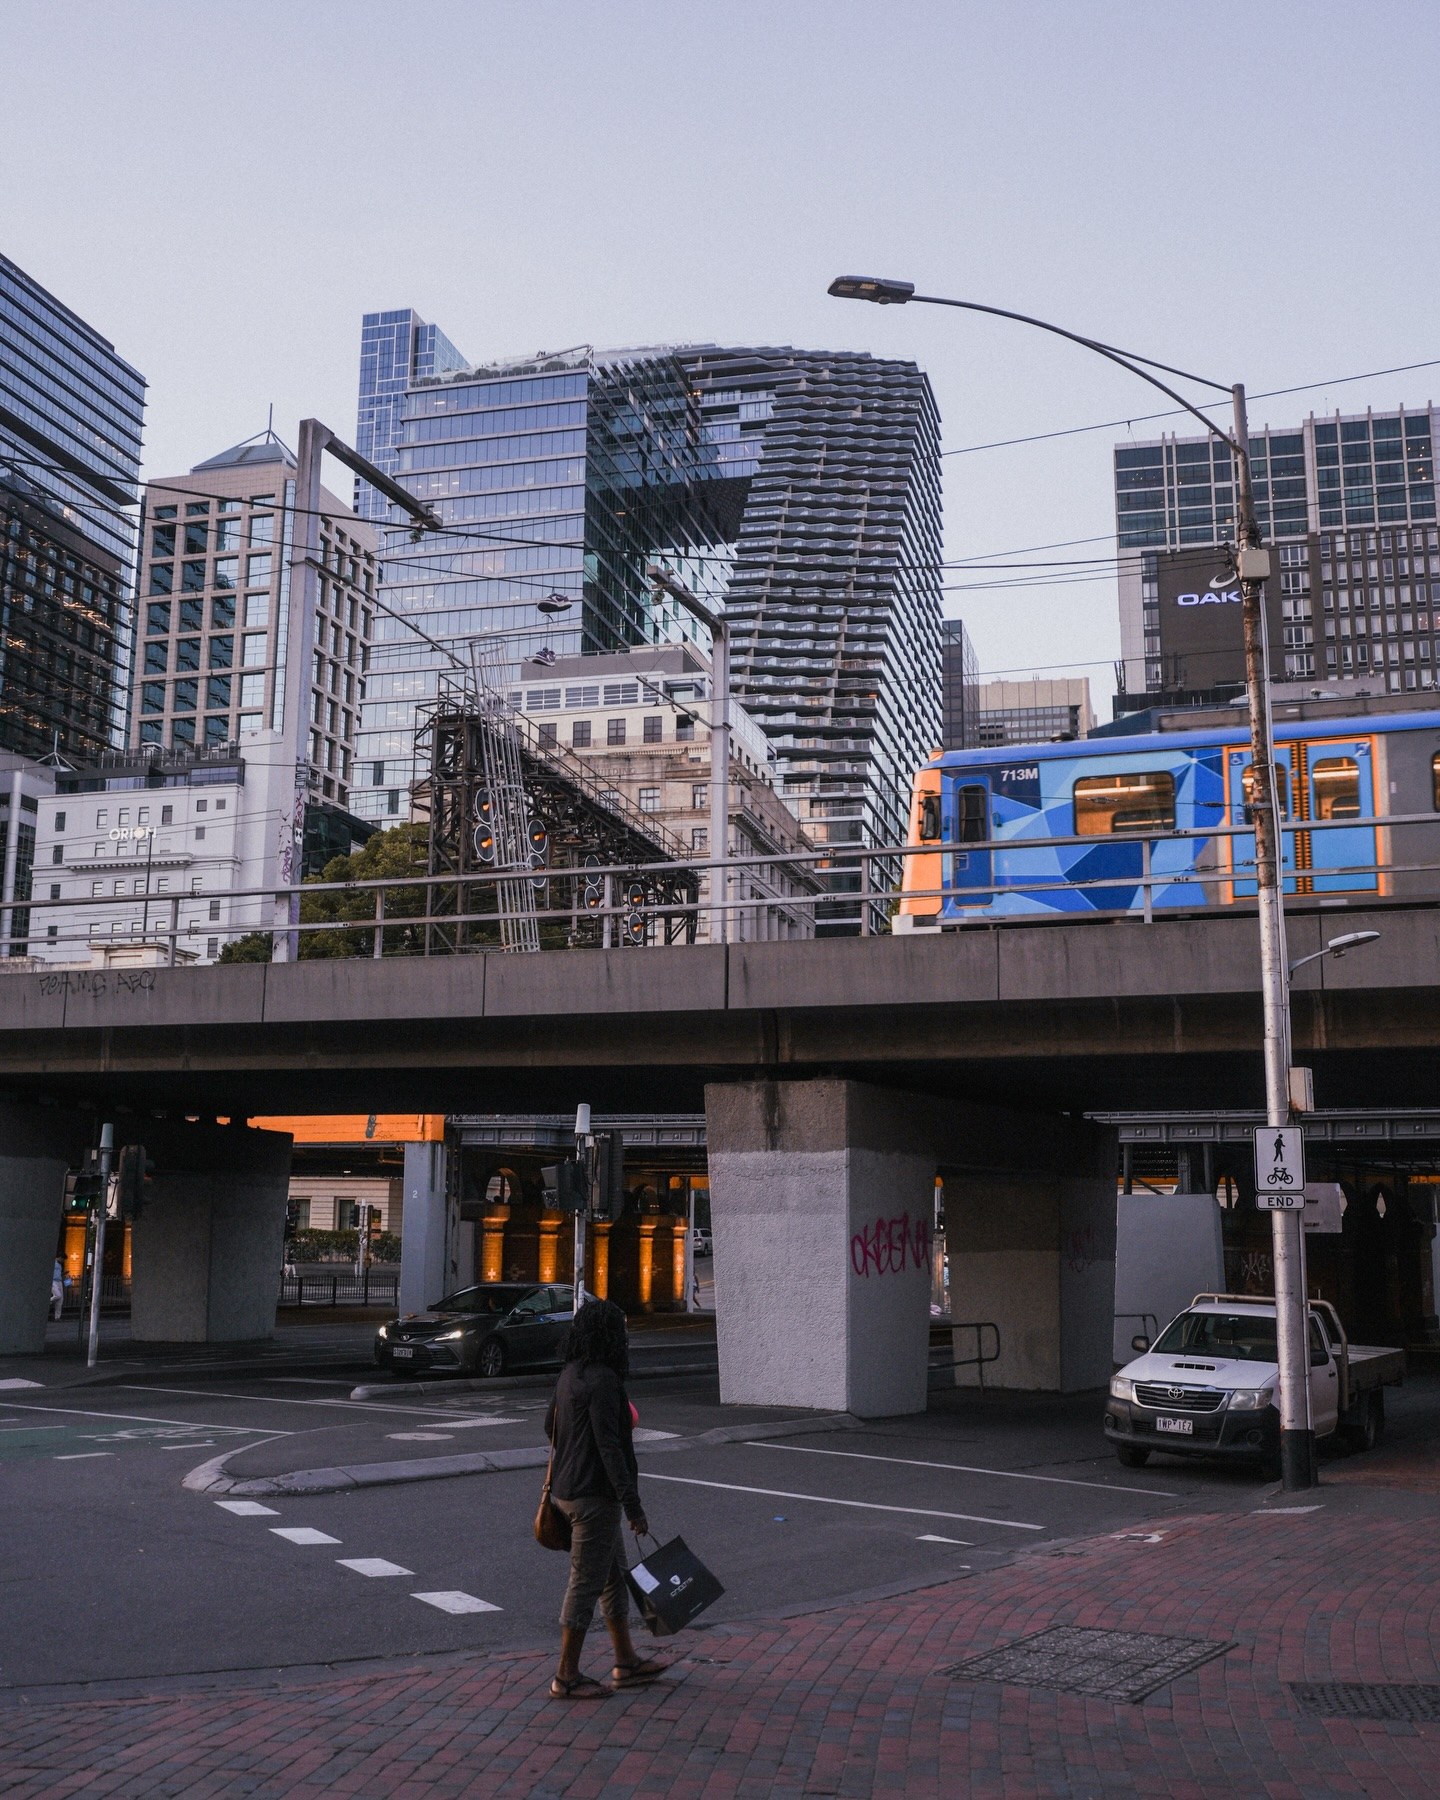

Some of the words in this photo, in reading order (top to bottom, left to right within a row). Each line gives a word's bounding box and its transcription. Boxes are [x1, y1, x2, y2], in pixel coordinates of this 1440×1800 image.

[1000, 767, 1039, 782] 713M
[109, 827, 157, 840] ORION
[1267, 1197, 1294, 1207] END
